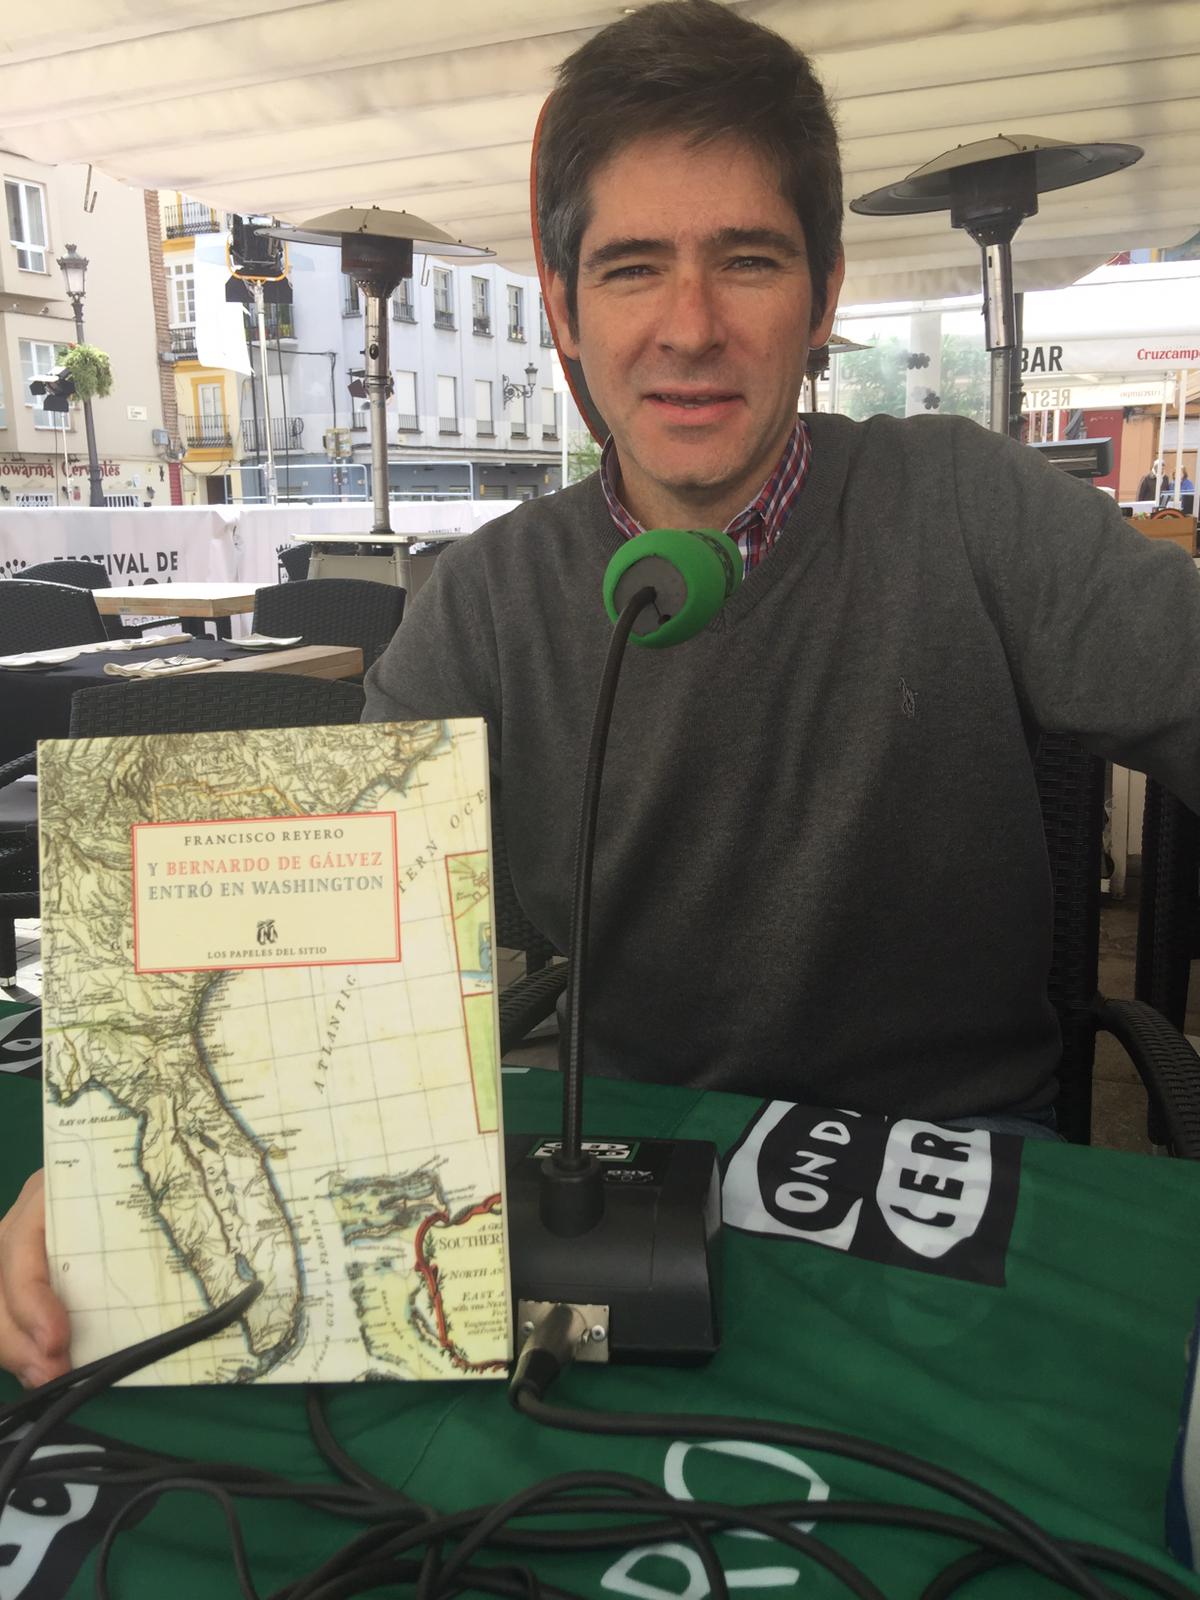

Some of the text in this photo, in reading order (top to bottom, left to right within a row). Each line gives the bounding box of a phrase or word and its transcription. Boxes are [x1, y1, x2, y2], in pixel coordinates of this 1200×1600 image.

[1019, 346, 1063, 373] BAR
[1136, 348, 1200, 361] Cruzcamp
[156, 551, 178, 572] DE
[184, 828, 345, 847] FRANCISCO REYERO
[148, 851, 384, 877] Y BERNARDO DE GÁLVEZ
[149, 875, 385, 901] ENTRÓ EN WASHINGTON
[207, 946, 328, 960] LOS PAPELES DEL SITIO
